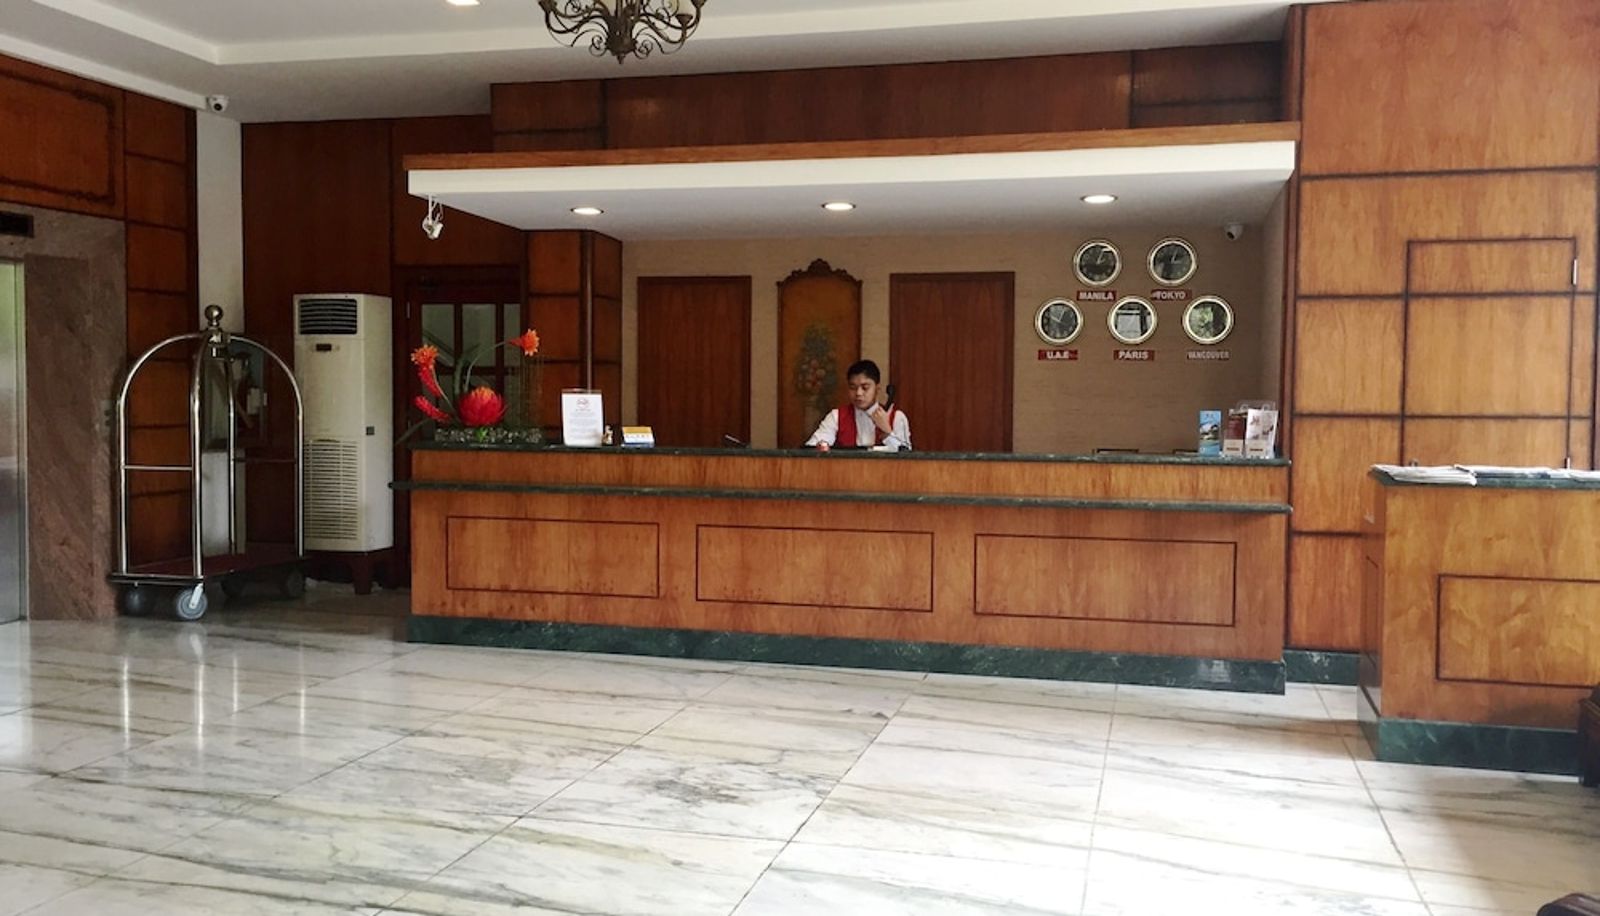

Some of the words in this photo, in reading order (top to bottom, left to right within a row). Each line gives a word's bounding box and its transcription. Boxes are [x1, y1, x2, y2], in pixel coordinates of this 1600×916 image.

[1079, 292, 1114, 300] MANILA
[1156, 291, 1186, 299] TOKYO
[1118, 351, 1149, 359] PARIS
